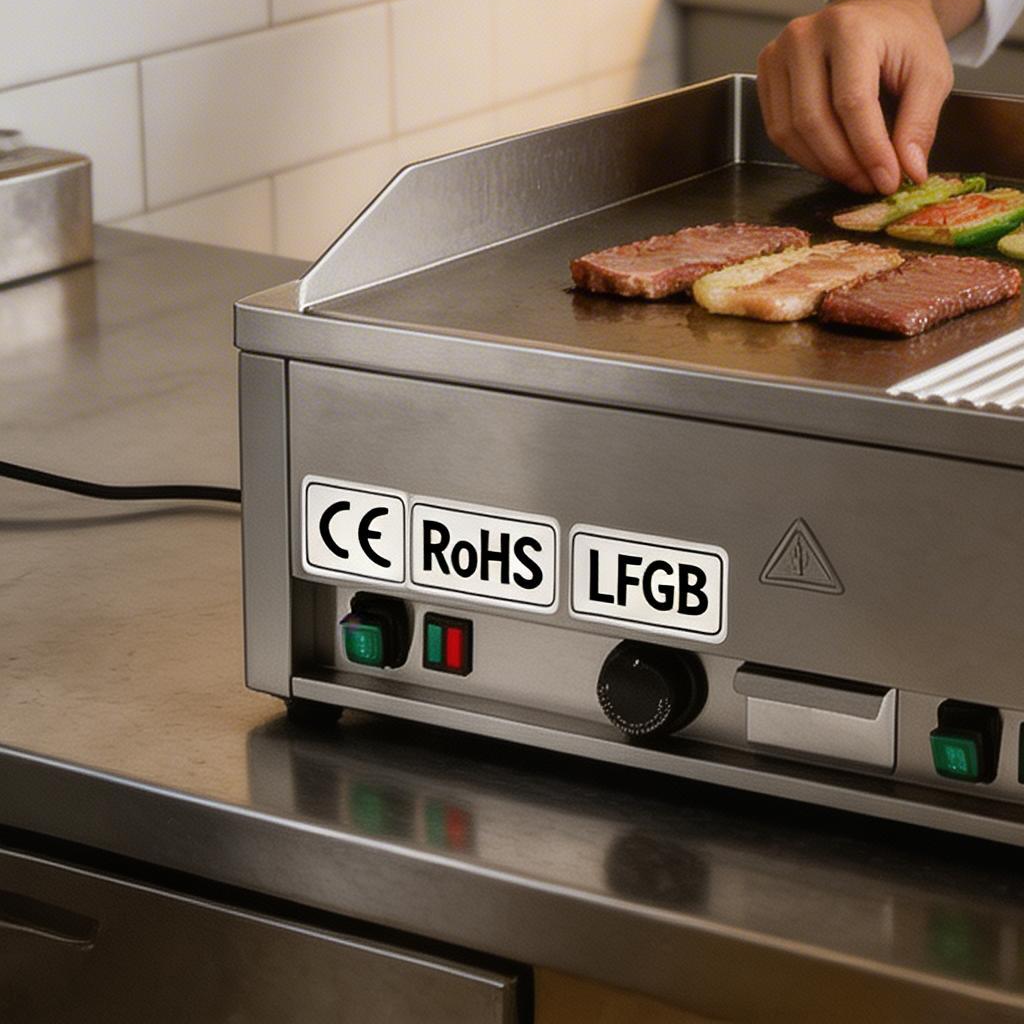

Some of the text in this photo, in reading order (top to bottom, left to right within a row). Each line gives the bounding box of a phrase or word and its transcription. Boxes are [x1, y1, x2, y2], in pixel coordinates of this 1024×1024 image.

[319, 500, 392, 568] CE
[422, 519, 544, 590] RoHS
[588, 548, 709, 616] LFGB
